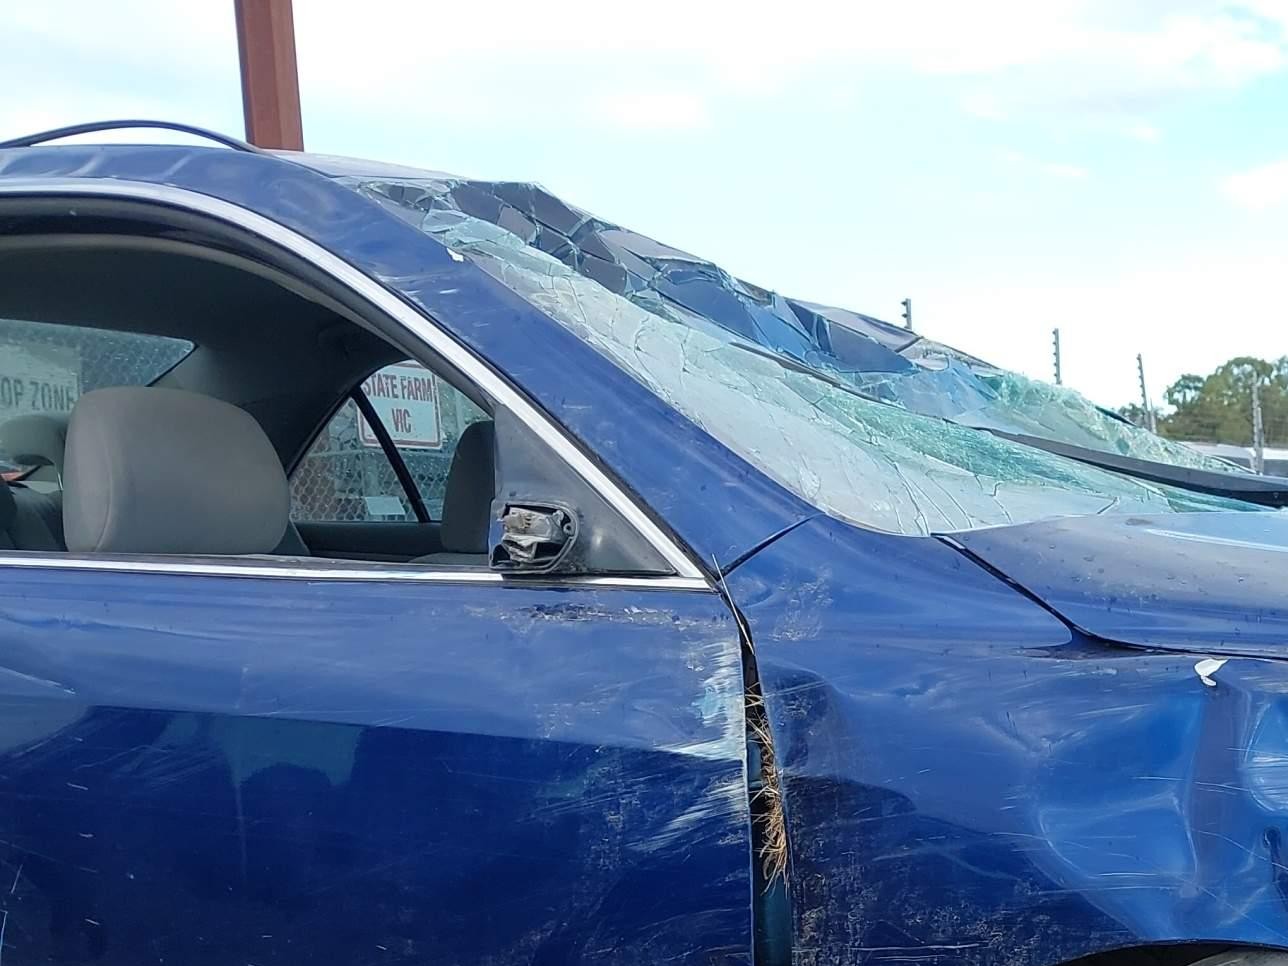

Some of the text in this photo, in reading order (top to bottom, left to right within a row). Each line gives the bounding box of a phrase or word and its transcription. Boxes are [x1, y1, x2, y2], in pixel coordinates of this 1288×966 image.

[362, 373, 433, 402] STATE FARM
[392, 408, 412, 433] VIC
